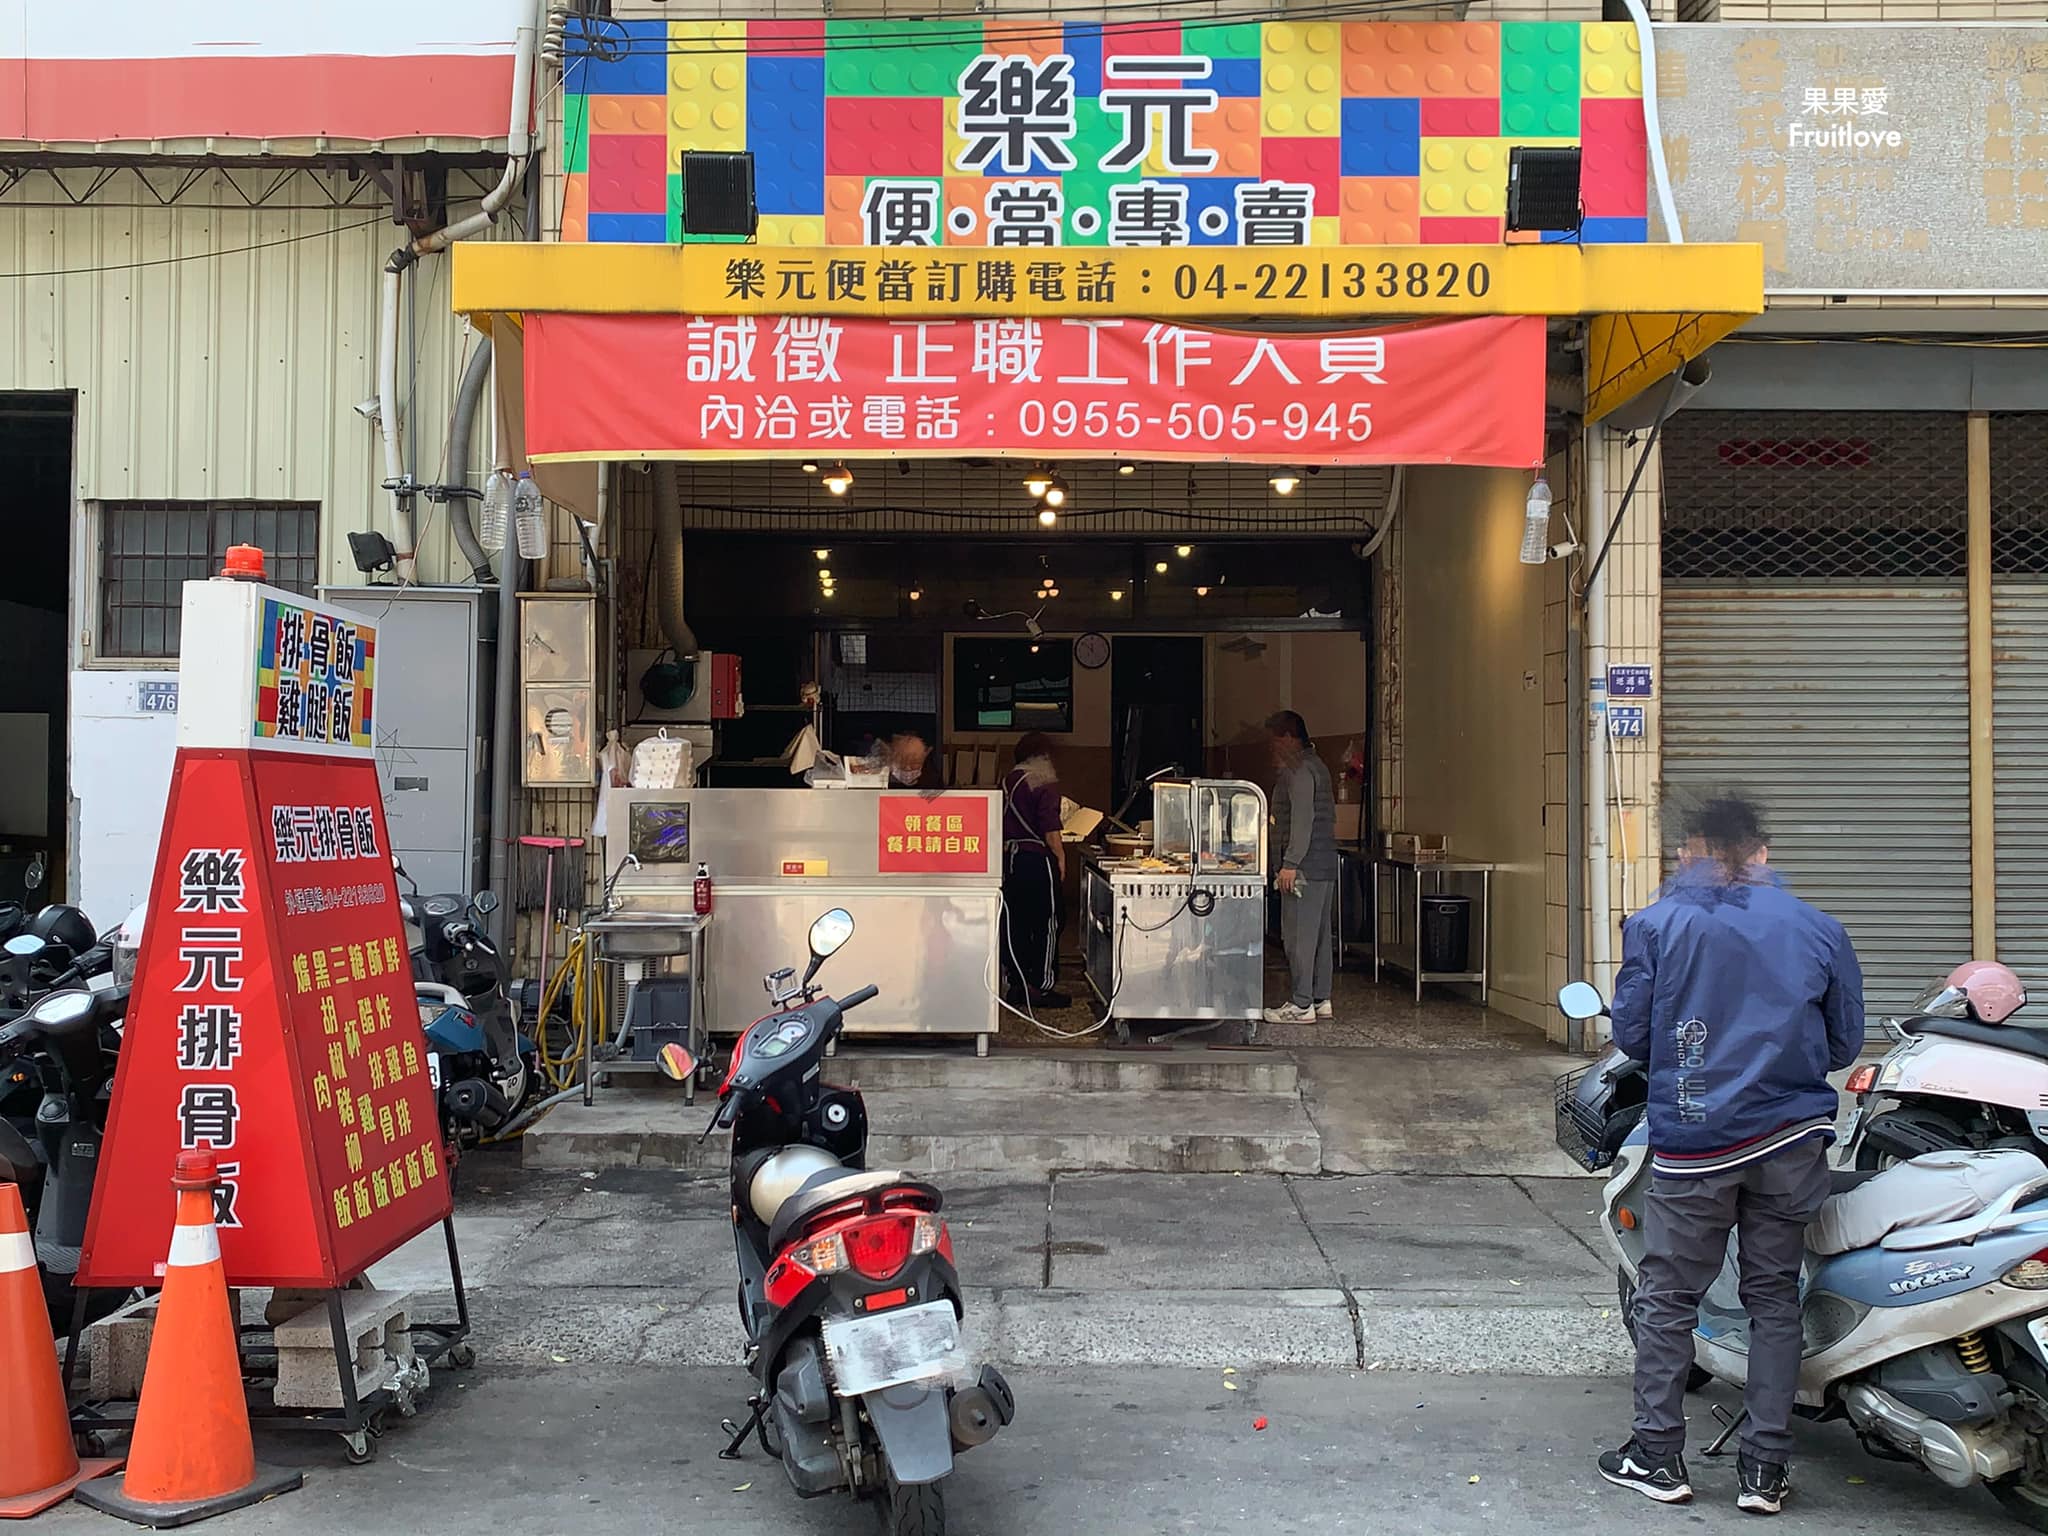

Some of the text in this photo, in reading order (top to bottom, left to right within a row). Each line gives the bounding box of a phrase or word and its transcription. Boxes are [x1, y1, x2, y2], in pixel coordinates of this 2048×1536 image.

[958, 54, 1218, 173] 樂元
[280, 608, 356, 682] 排骨飯
[1625, 686, 1635, 694] 27
[147, 694, 176, 710] 476
[277, 677, 353, 744] 雞腿飯
[1611, 719, 1641, 736] 474
[904, 815, 963, 832] 領餐區
[273, 805, 380, 862] 樂元排骨飯
[887, 836, 980, 853] 餐具請自取
